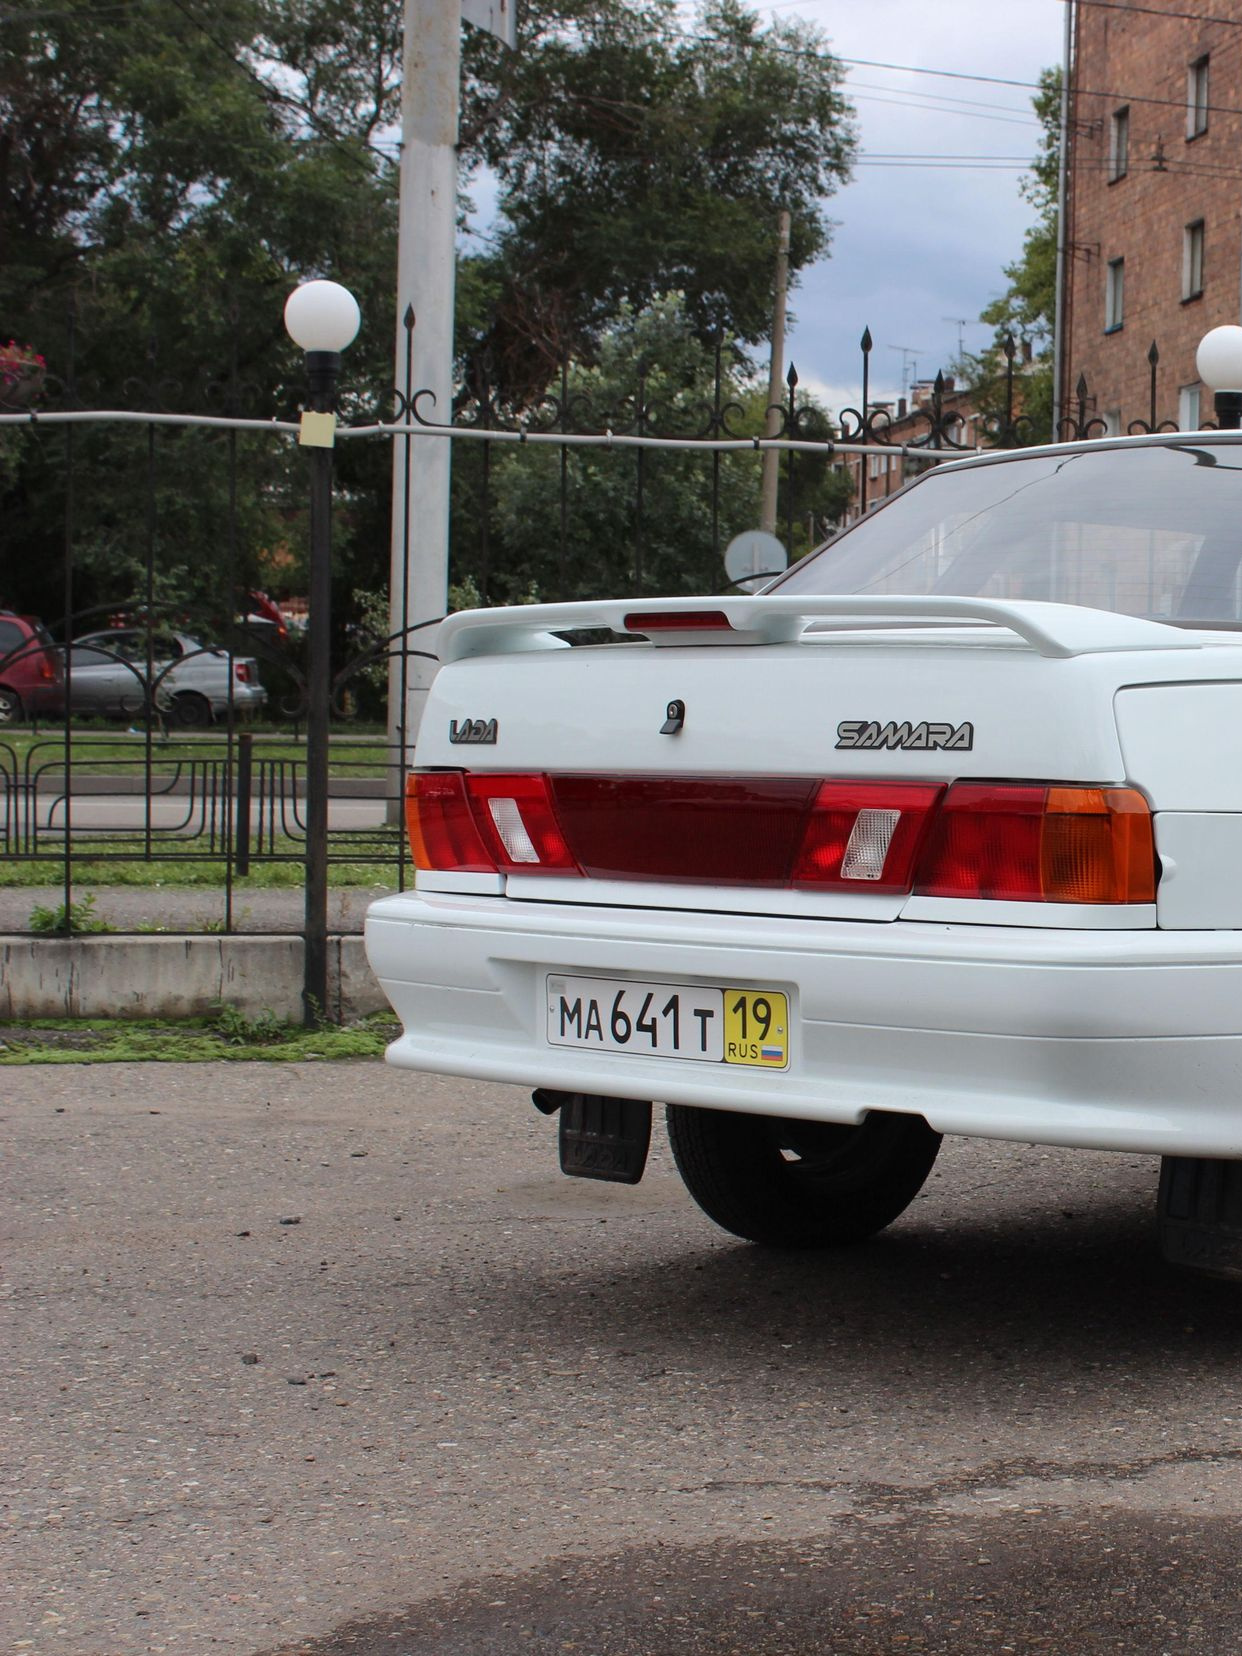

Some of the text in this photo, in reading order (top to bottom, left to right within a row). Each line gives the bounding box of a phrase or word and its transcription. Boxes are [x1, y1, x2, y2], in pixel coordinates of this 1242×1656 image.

[449, 719, 498, 745] LADA
[835, 721, 974, 751] SAMARA
[732, 995, 772, 1041] 19
[727, 1042, 759, 1060] RUS
